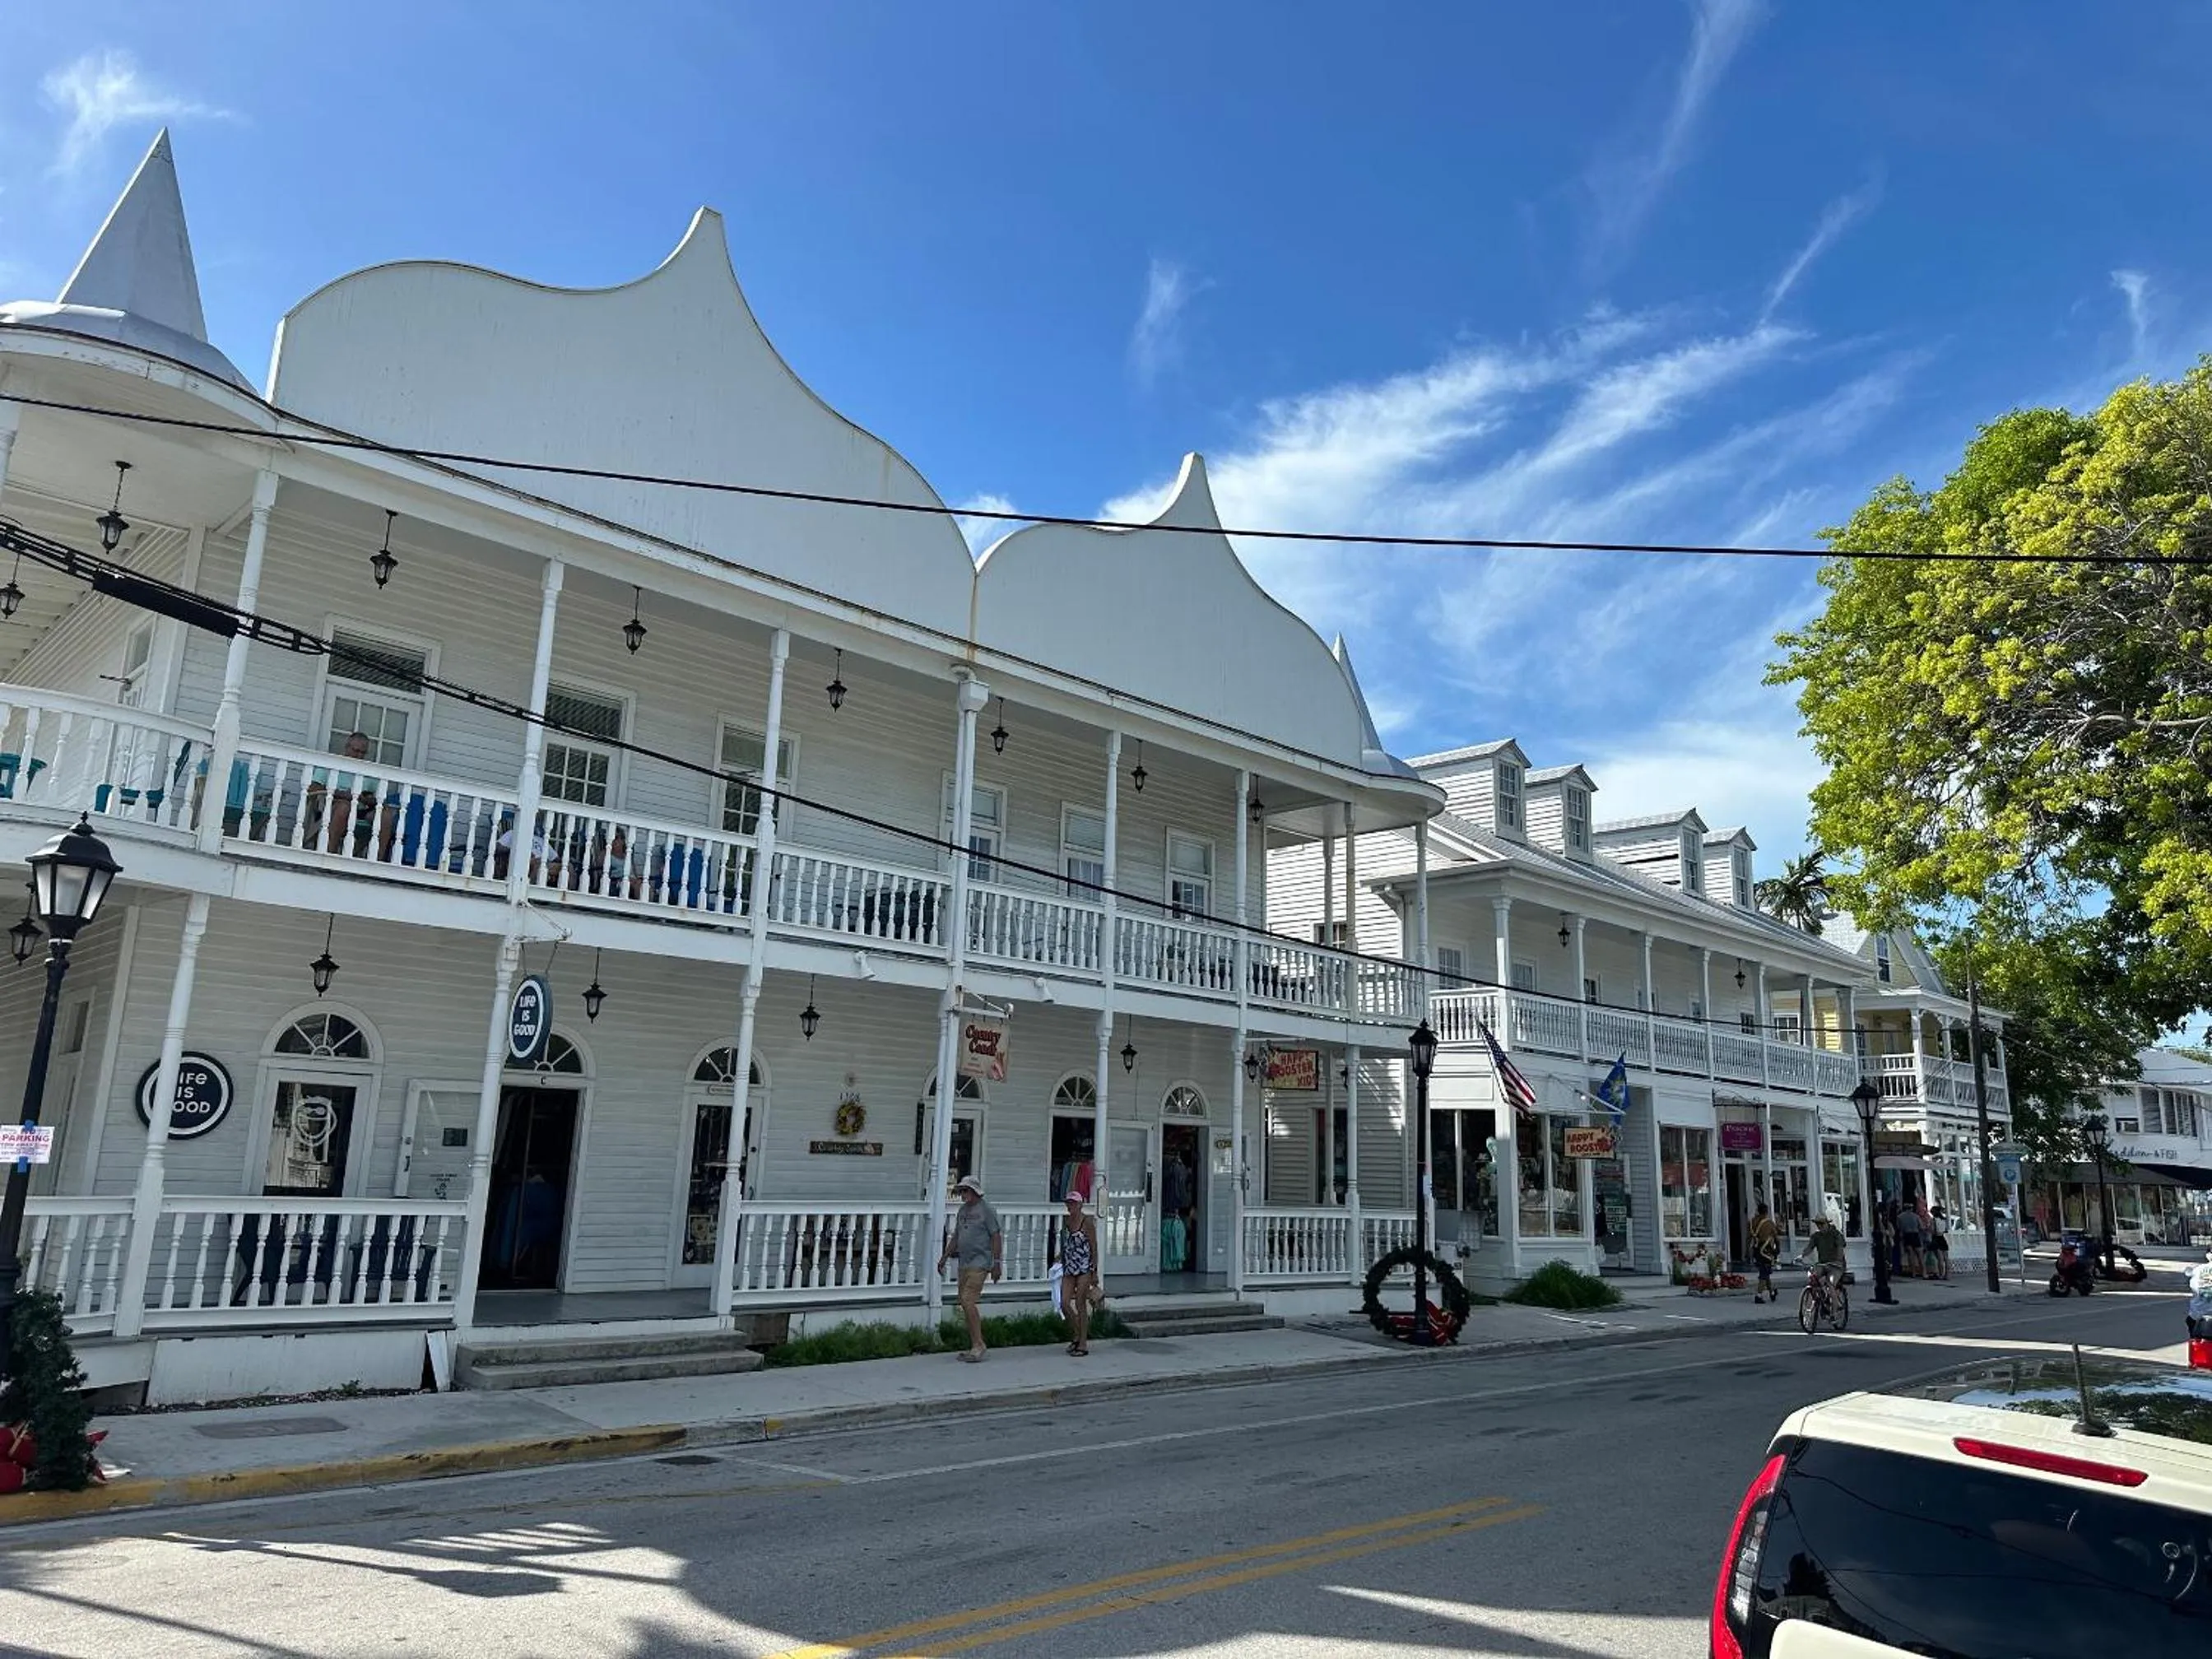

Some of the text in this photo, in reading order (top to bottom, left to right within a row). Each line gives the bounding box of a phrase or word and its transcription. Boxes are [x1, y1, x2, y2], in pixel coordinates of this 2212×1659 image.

[522, 1010, 530, 1021] IS
[514, 1024, 536, 1036] GOOD
[1278, 1060, 1314, 1076] OOSTER
[177, 1086, 194, 1099] IS
[173, 1100, 211, 1113] OOD
